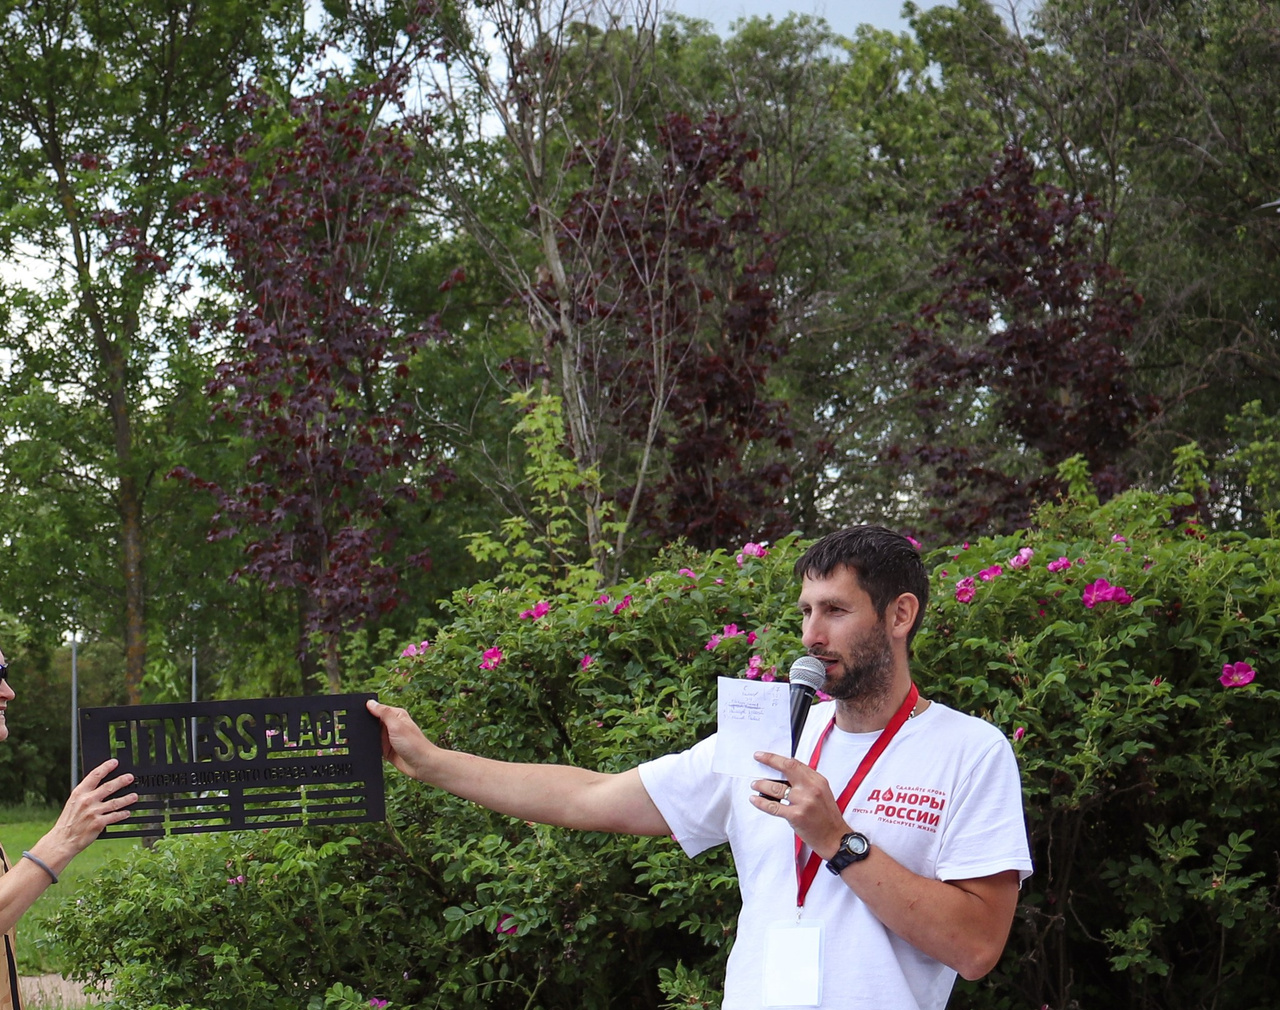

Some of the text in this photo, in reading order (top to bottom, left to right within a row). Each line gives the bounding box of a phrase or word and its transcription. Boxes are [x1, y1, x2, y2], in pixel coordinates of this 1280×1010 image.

[108, 709, 349, 767] FITNESS PLACE
[131, 762, 354, 788] РИТОРИЯ ЗДОРОВОГО ОБРАЗА ЖИЗНИ
[874, 804, 940, 827] РОССИИ
